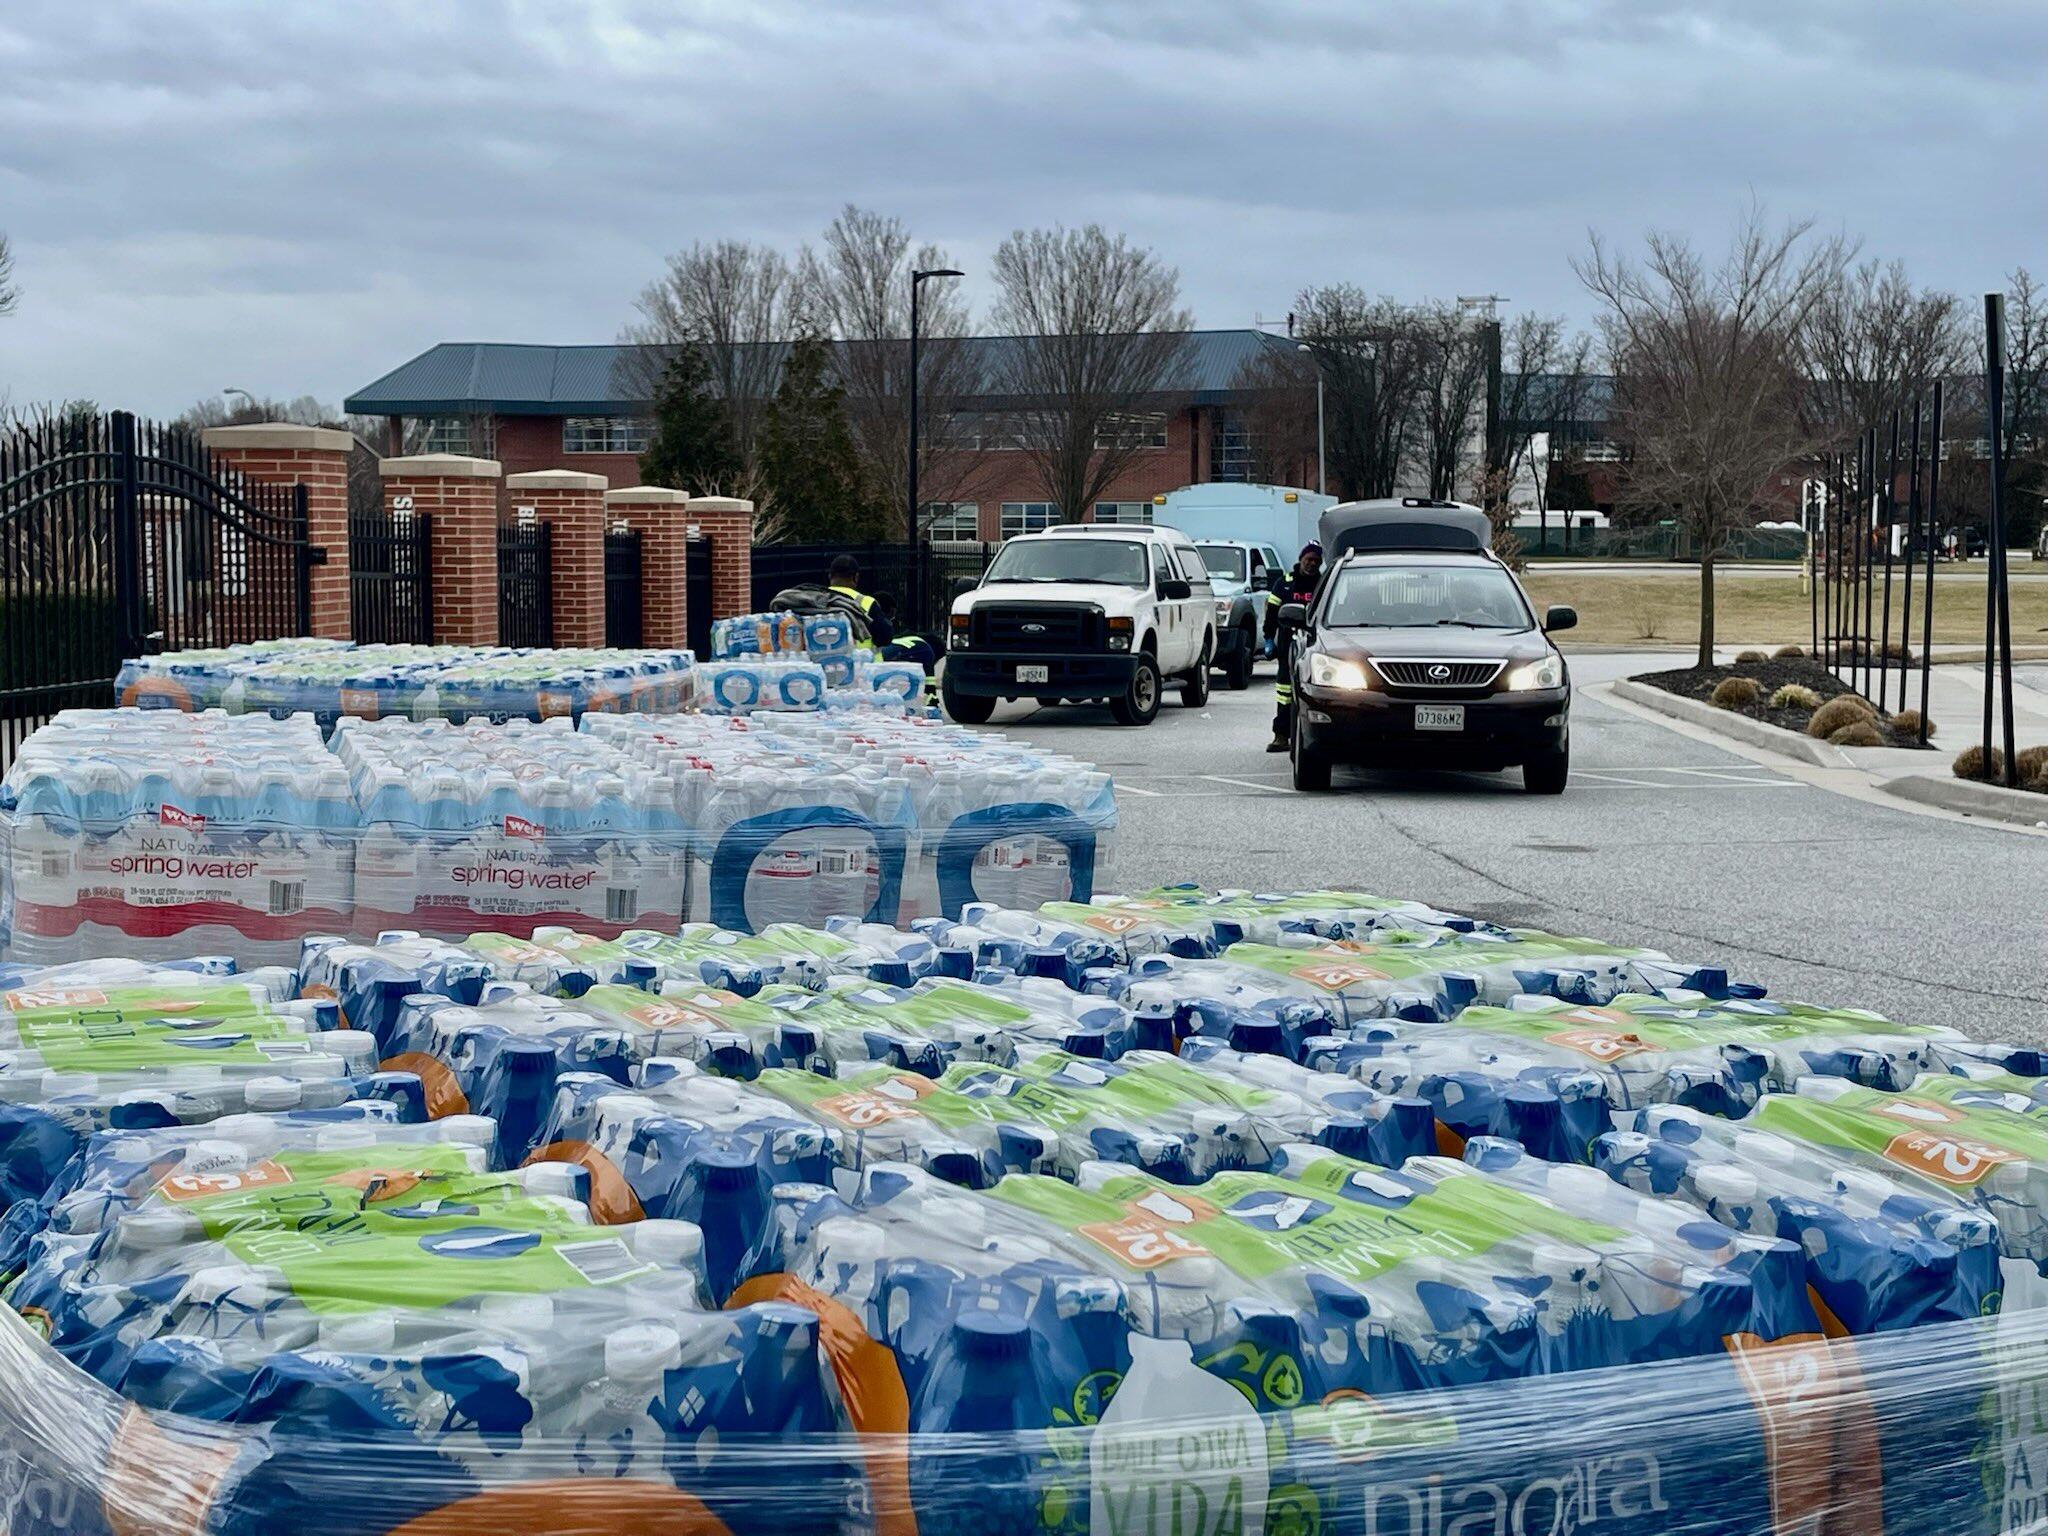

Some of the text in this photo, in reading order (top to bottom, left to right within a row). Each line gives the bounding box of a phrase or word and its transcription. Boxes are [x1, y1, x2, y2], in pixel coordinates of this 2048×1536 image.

[141, 838, 216, 856] NATURAL
[486, 848, 558, 867] NATURAL
[110, 854, 259, 879] spring water
[452, 863, 596, 890] spring water
[1100, 1476, 1244, 1536] VIDA
